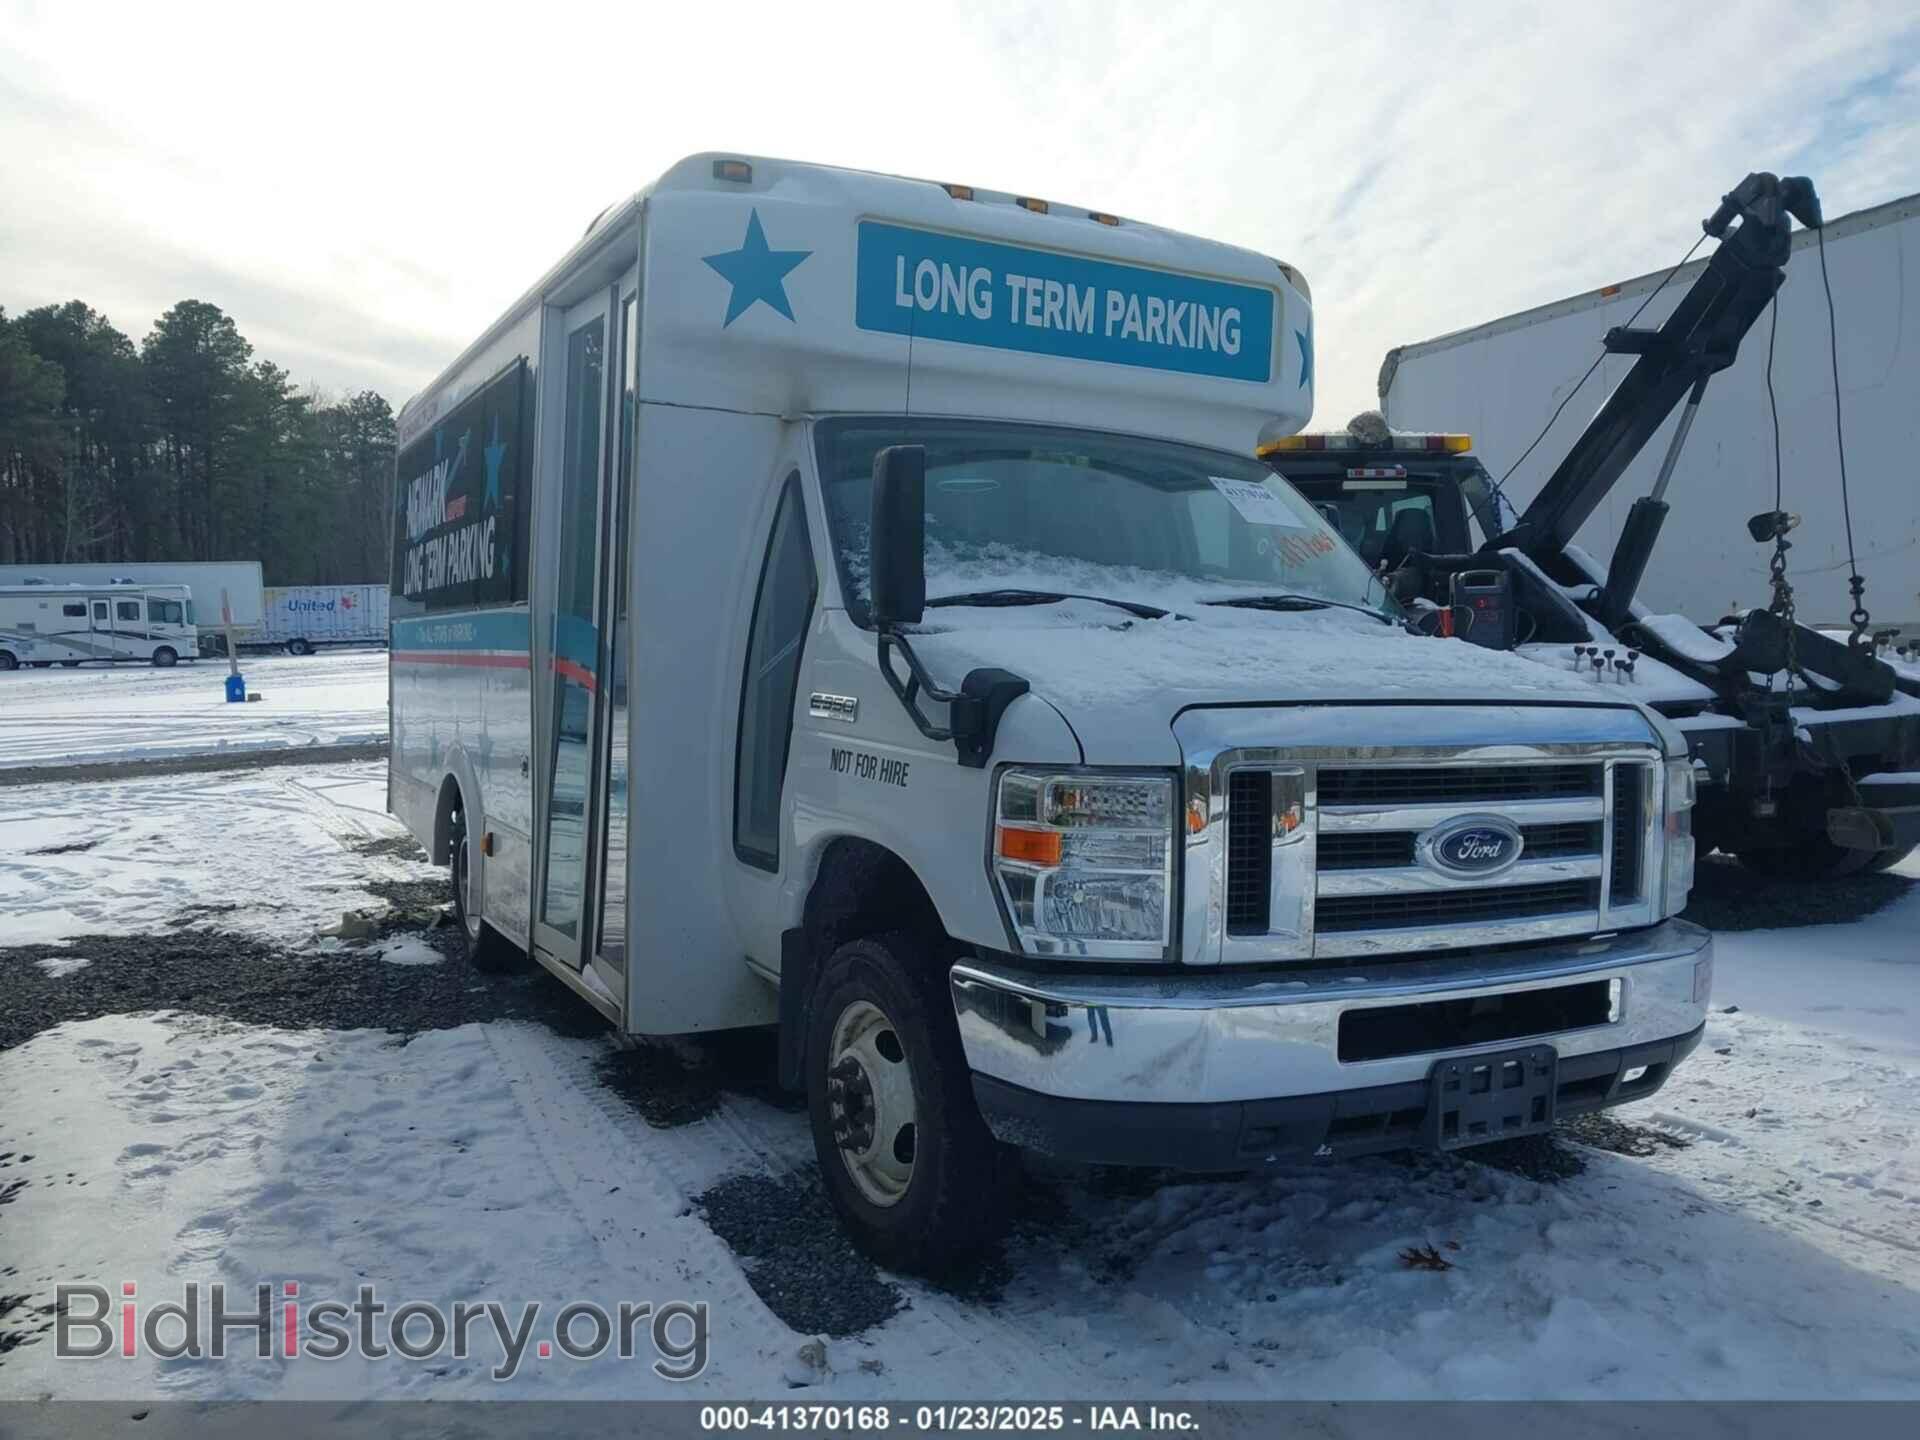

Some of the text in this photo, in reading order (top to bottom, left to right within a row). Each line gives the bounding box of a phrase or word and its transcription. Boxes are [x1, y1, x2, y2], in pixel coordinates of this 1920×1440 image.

[896, 255, 1241, 355] LONG TERM PARKING
[406, 458, 449, 541] NEWARK
[403, 515, 495, 596] LONG TERM PARKING
[287, 598, 335, 613] United
[830, 748, 910, 787] NOT FOR HIRE
[1458, 834, 1502, 859] Ford
